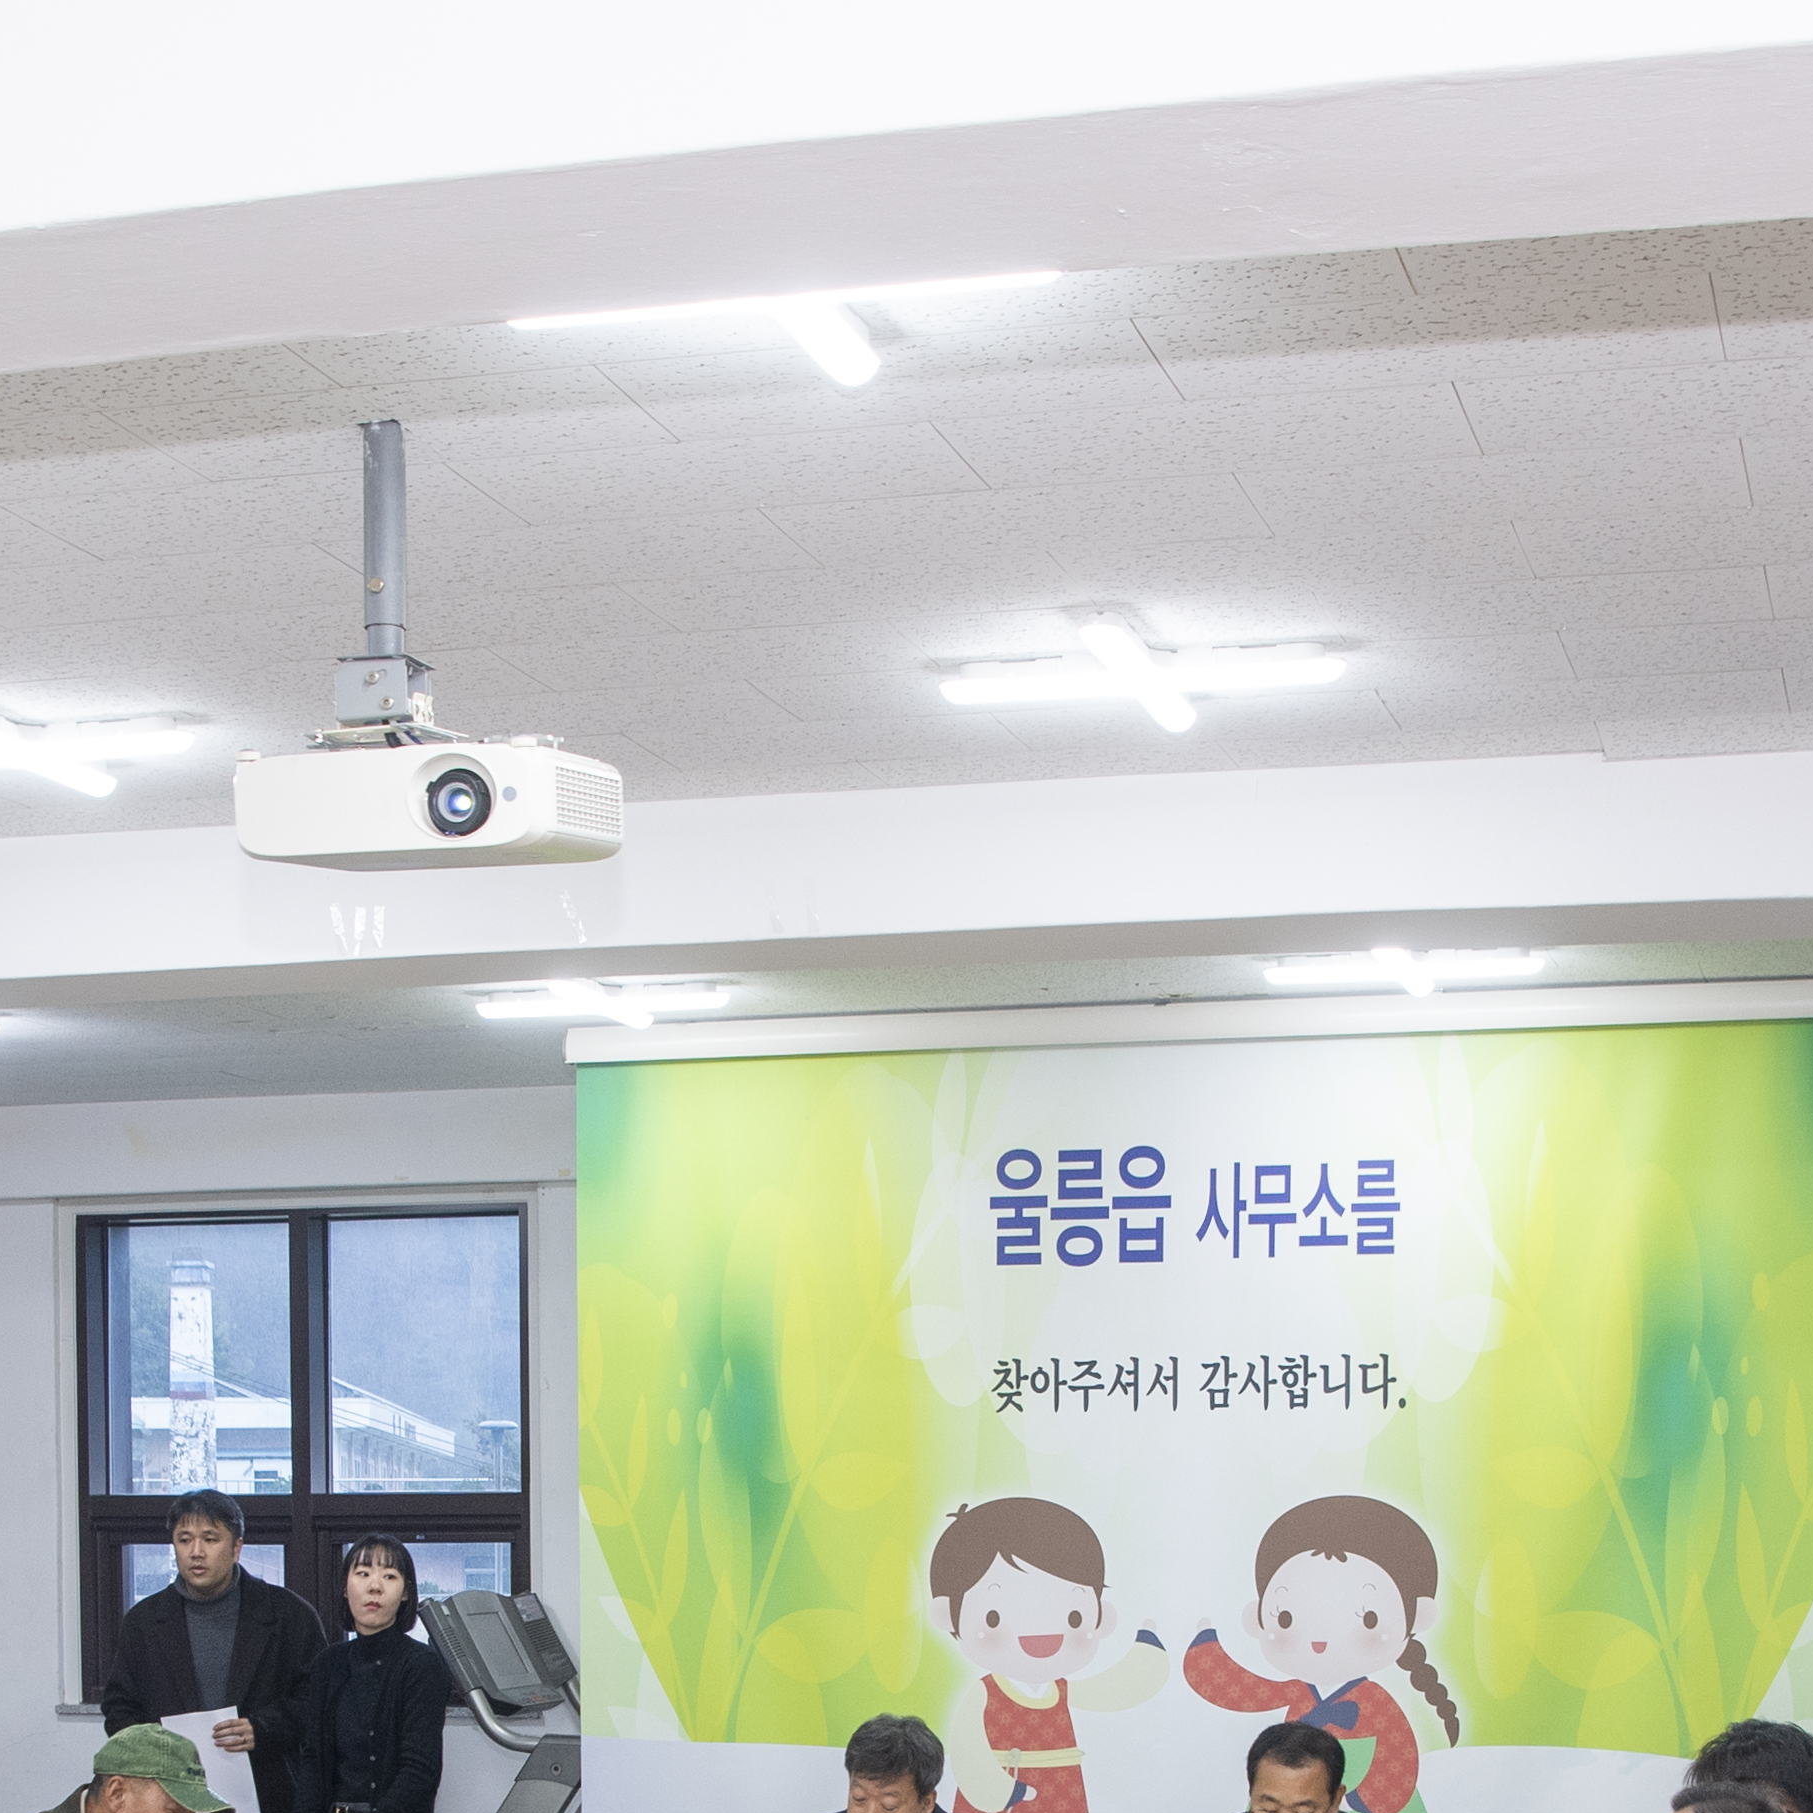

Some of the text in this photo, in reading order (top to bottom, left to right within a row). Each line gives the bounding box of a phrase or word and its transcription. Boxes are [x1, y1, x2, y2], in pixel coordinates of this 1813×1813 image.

[989, 1145, 1401, 1268] 울릉읍 사무소를
[990, 1353, 1408, 1414] 찾아주셔서 감사합니다.
